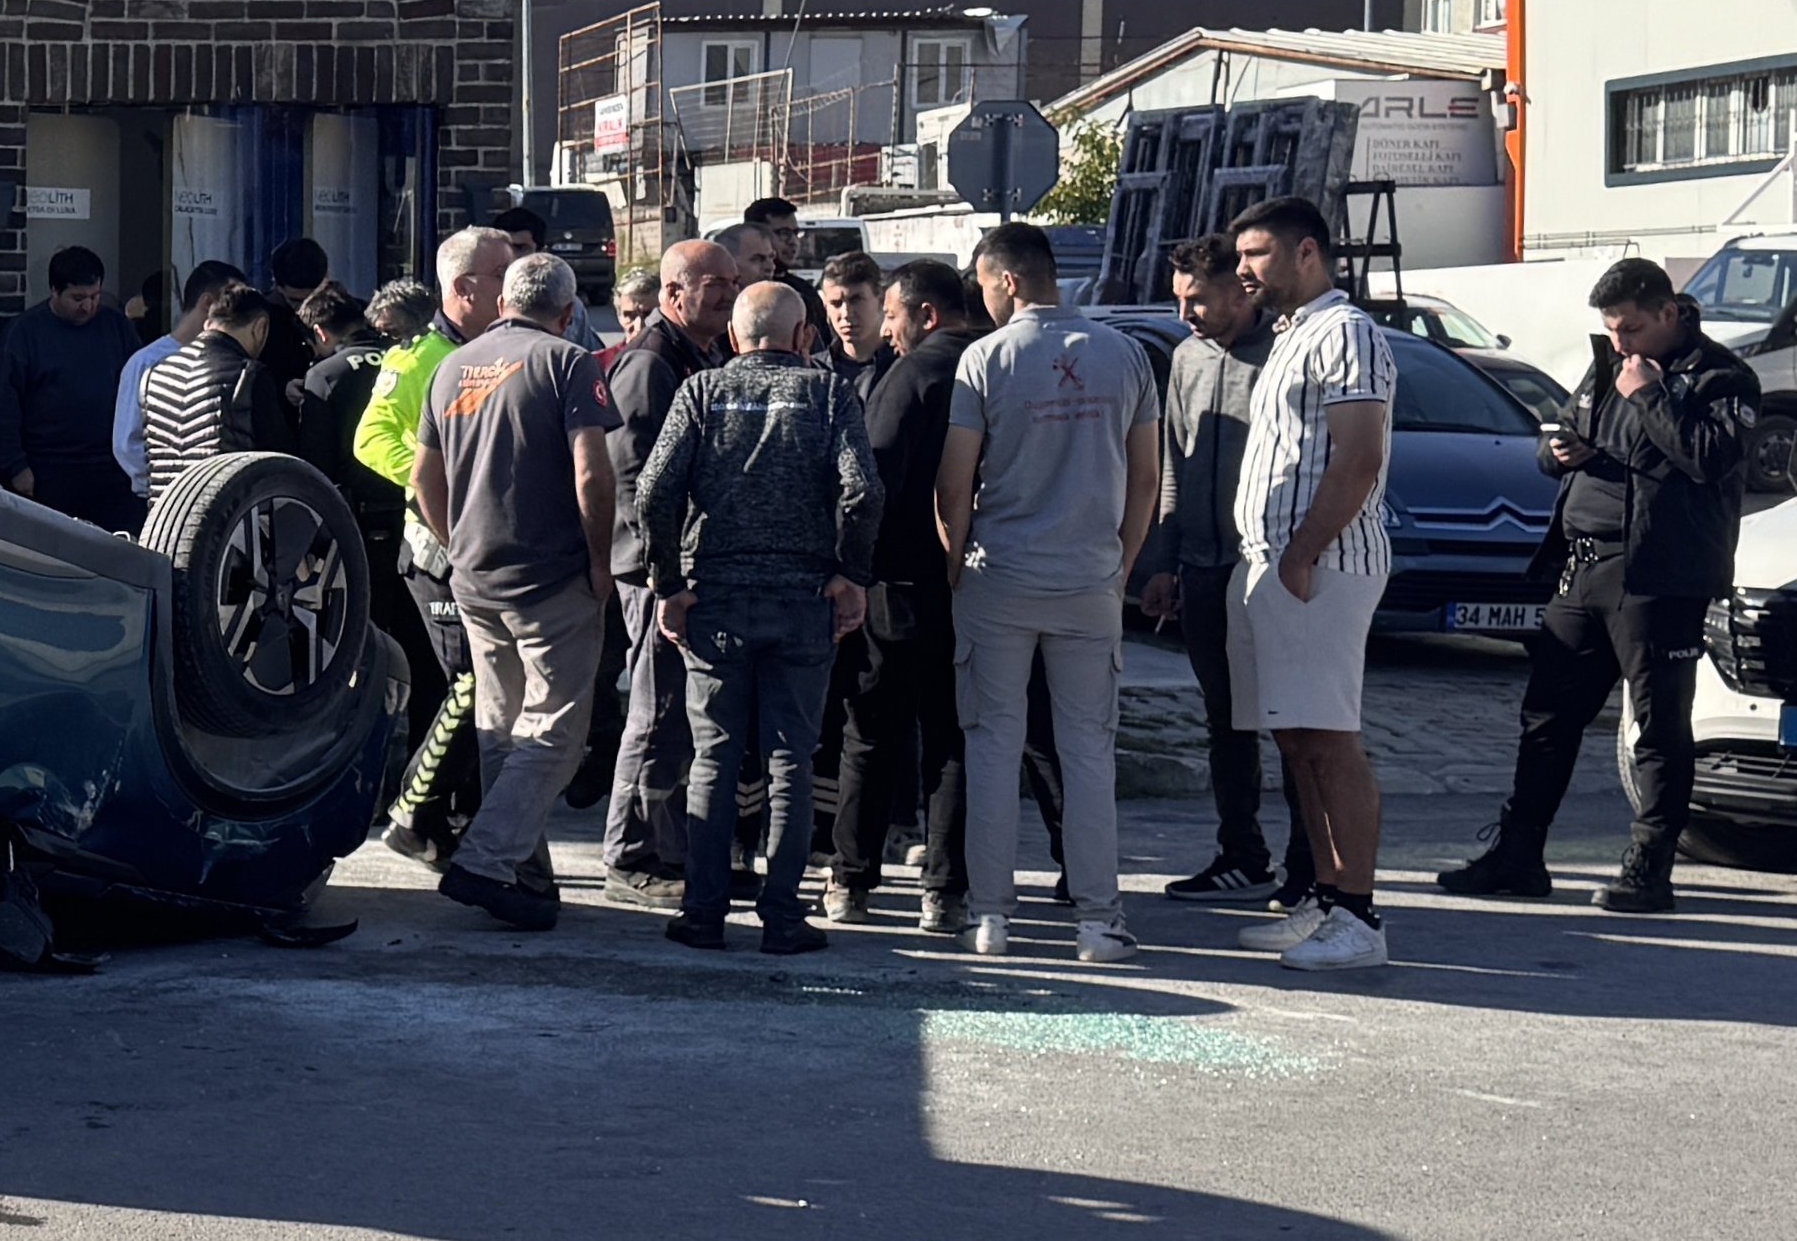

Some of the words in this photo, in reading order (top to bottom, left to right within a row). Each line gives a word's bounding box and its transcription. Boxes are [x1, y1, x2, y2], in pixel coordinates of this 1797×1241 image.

[1361, 96, 1479, 119] ARLE
[1413, 139, 1440, 149] KAPI
[1435, 152, 1461, 162] KAPI
[1428, 164, 1454, 173] KAPI
[1455, 605, 1481, 626] 34
[1488, 606, 1527, 626] MAH
